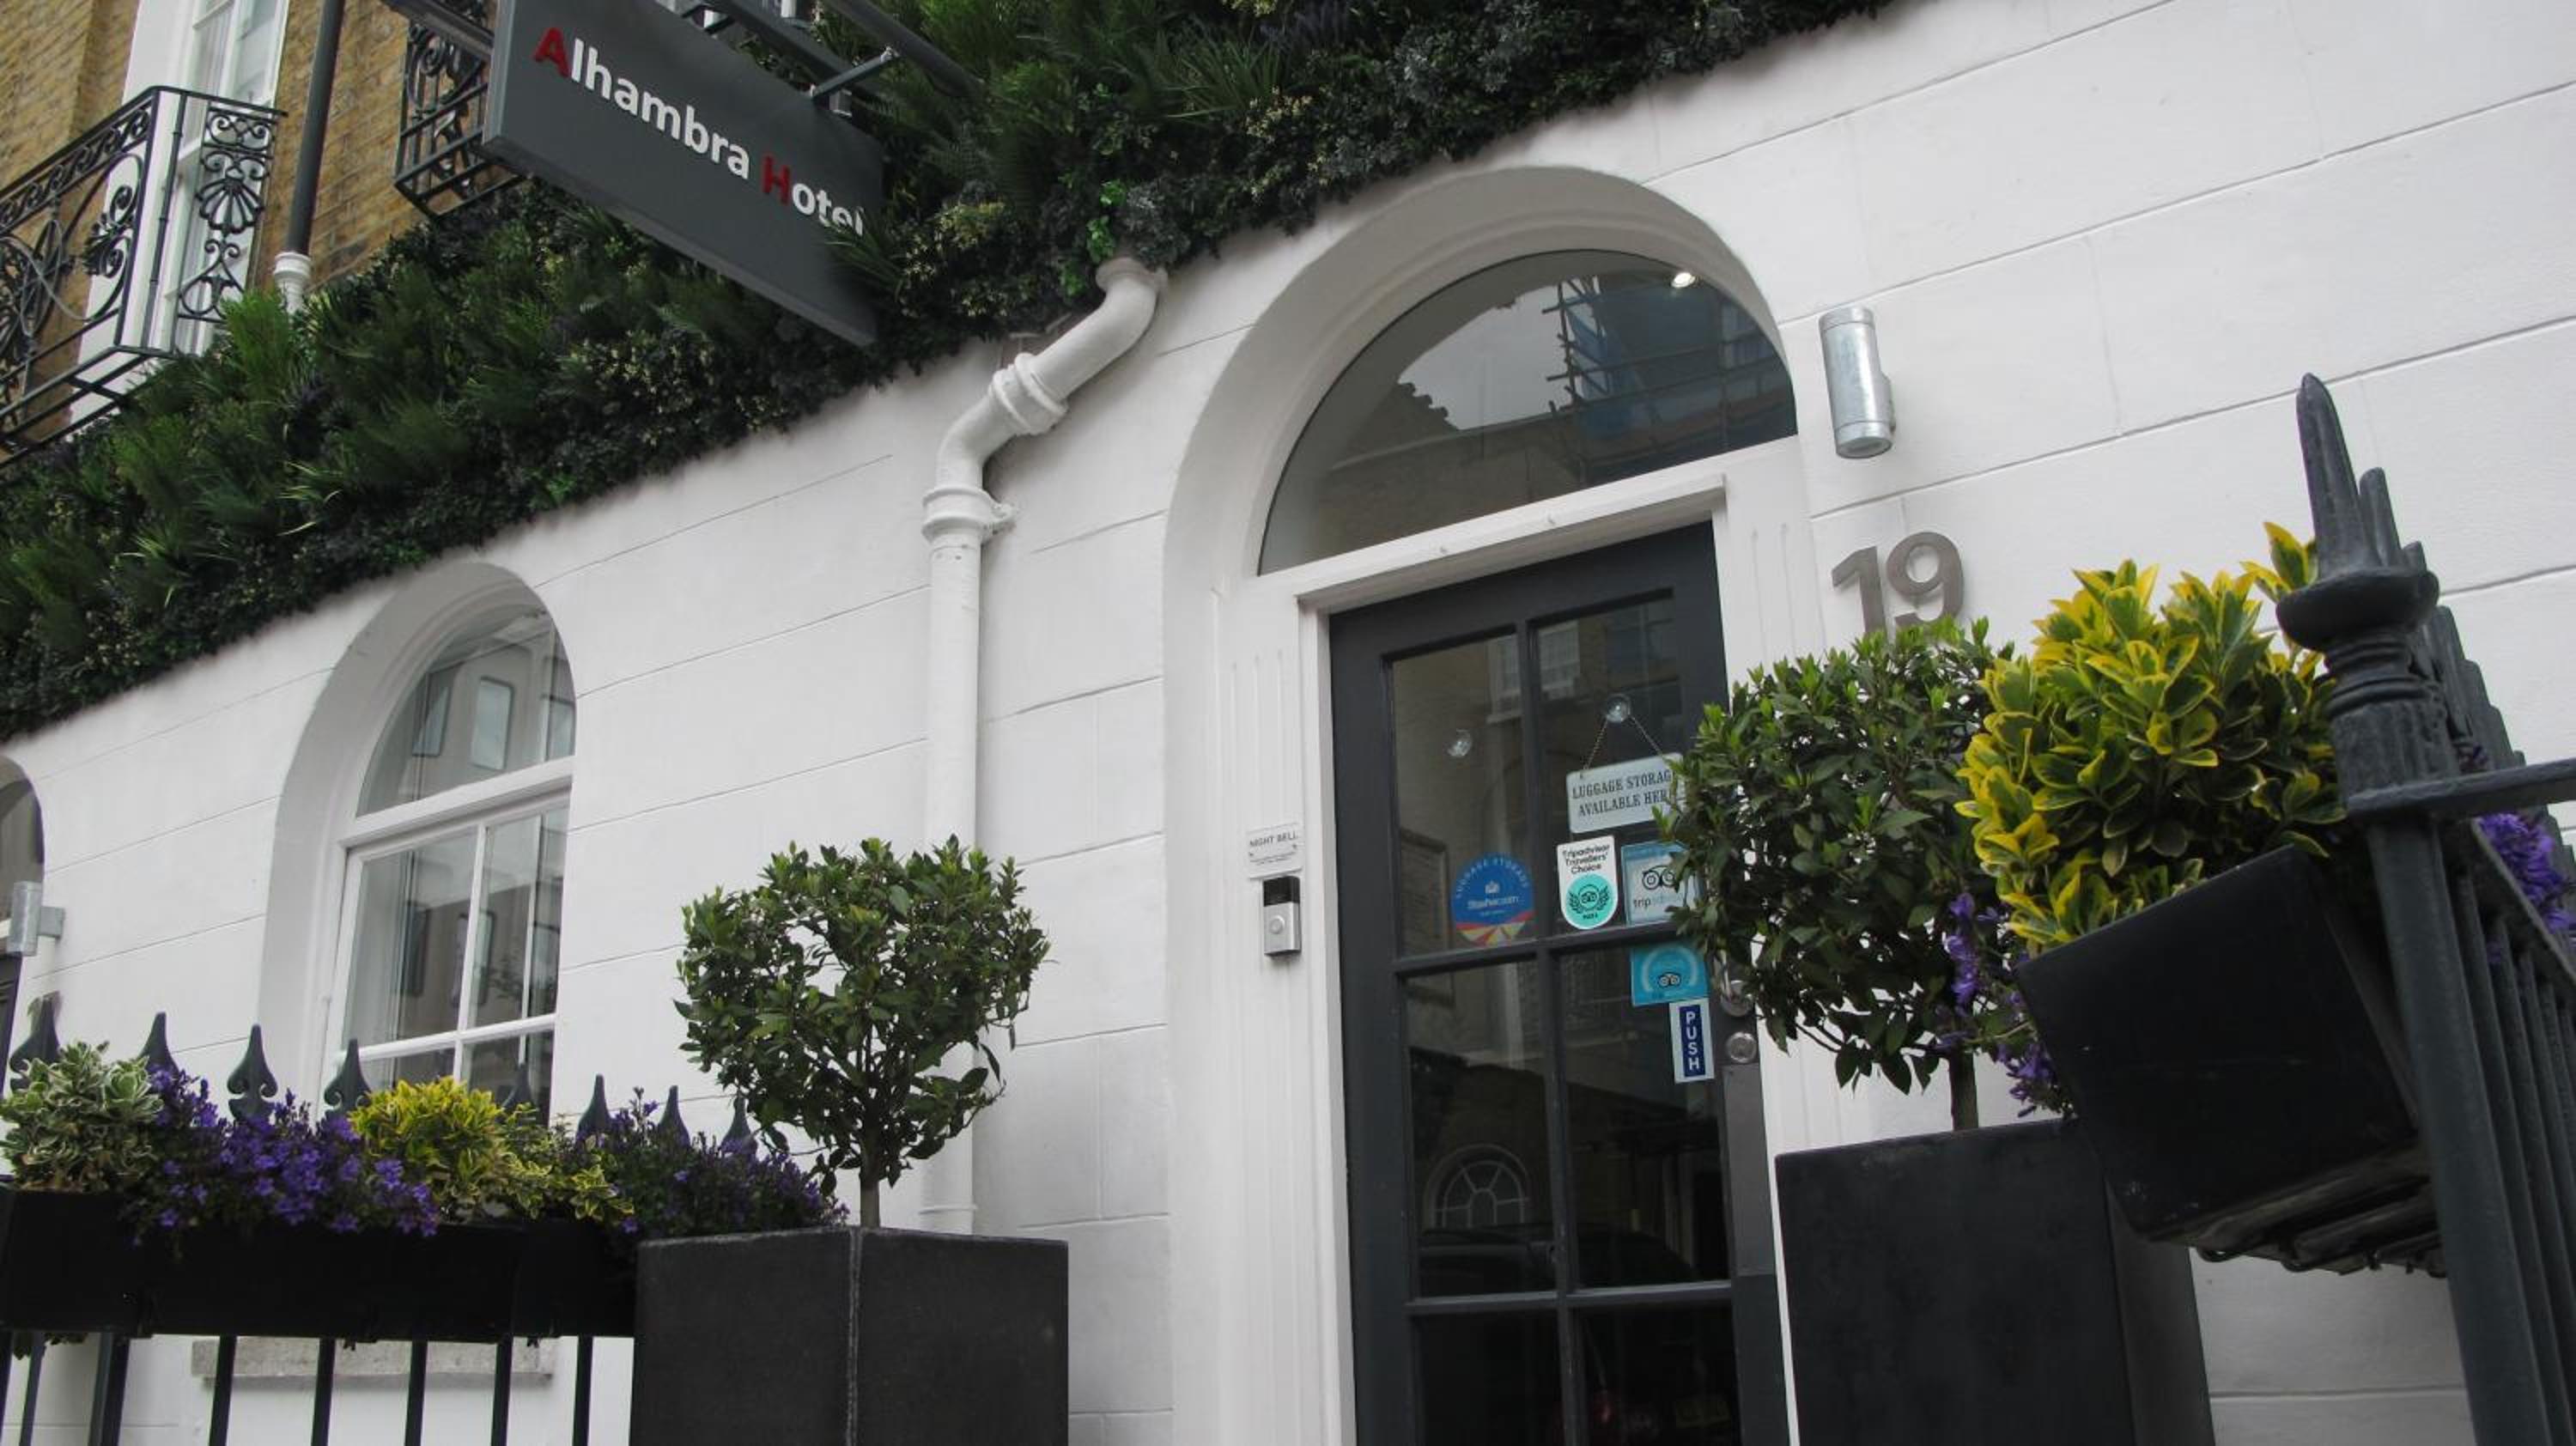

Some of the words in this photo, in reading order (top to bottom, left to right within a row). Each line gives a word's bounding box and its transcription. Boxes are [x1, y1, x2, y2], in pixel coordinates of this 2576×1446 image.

[532, 27, 750, 179] Alhambra
[1831, 531, 1965, 637] 19
[1572, 777, 1625, 799] LUGGAGE
[1625, 769, 1675, 789] STORAG
[1578, 793, 1641, 817] AVAILABLE
[1643, 787, 1672, 805] HER
[1249, 835, 1275, 848] NIGHT
[1277, 830, 1297, 842] BELL
[1563, 844, 1611, 858] Tripadvisor
[1571, 863, 1602, 874] Choice
[1685, 1011, 1701, 1071] PUSH
